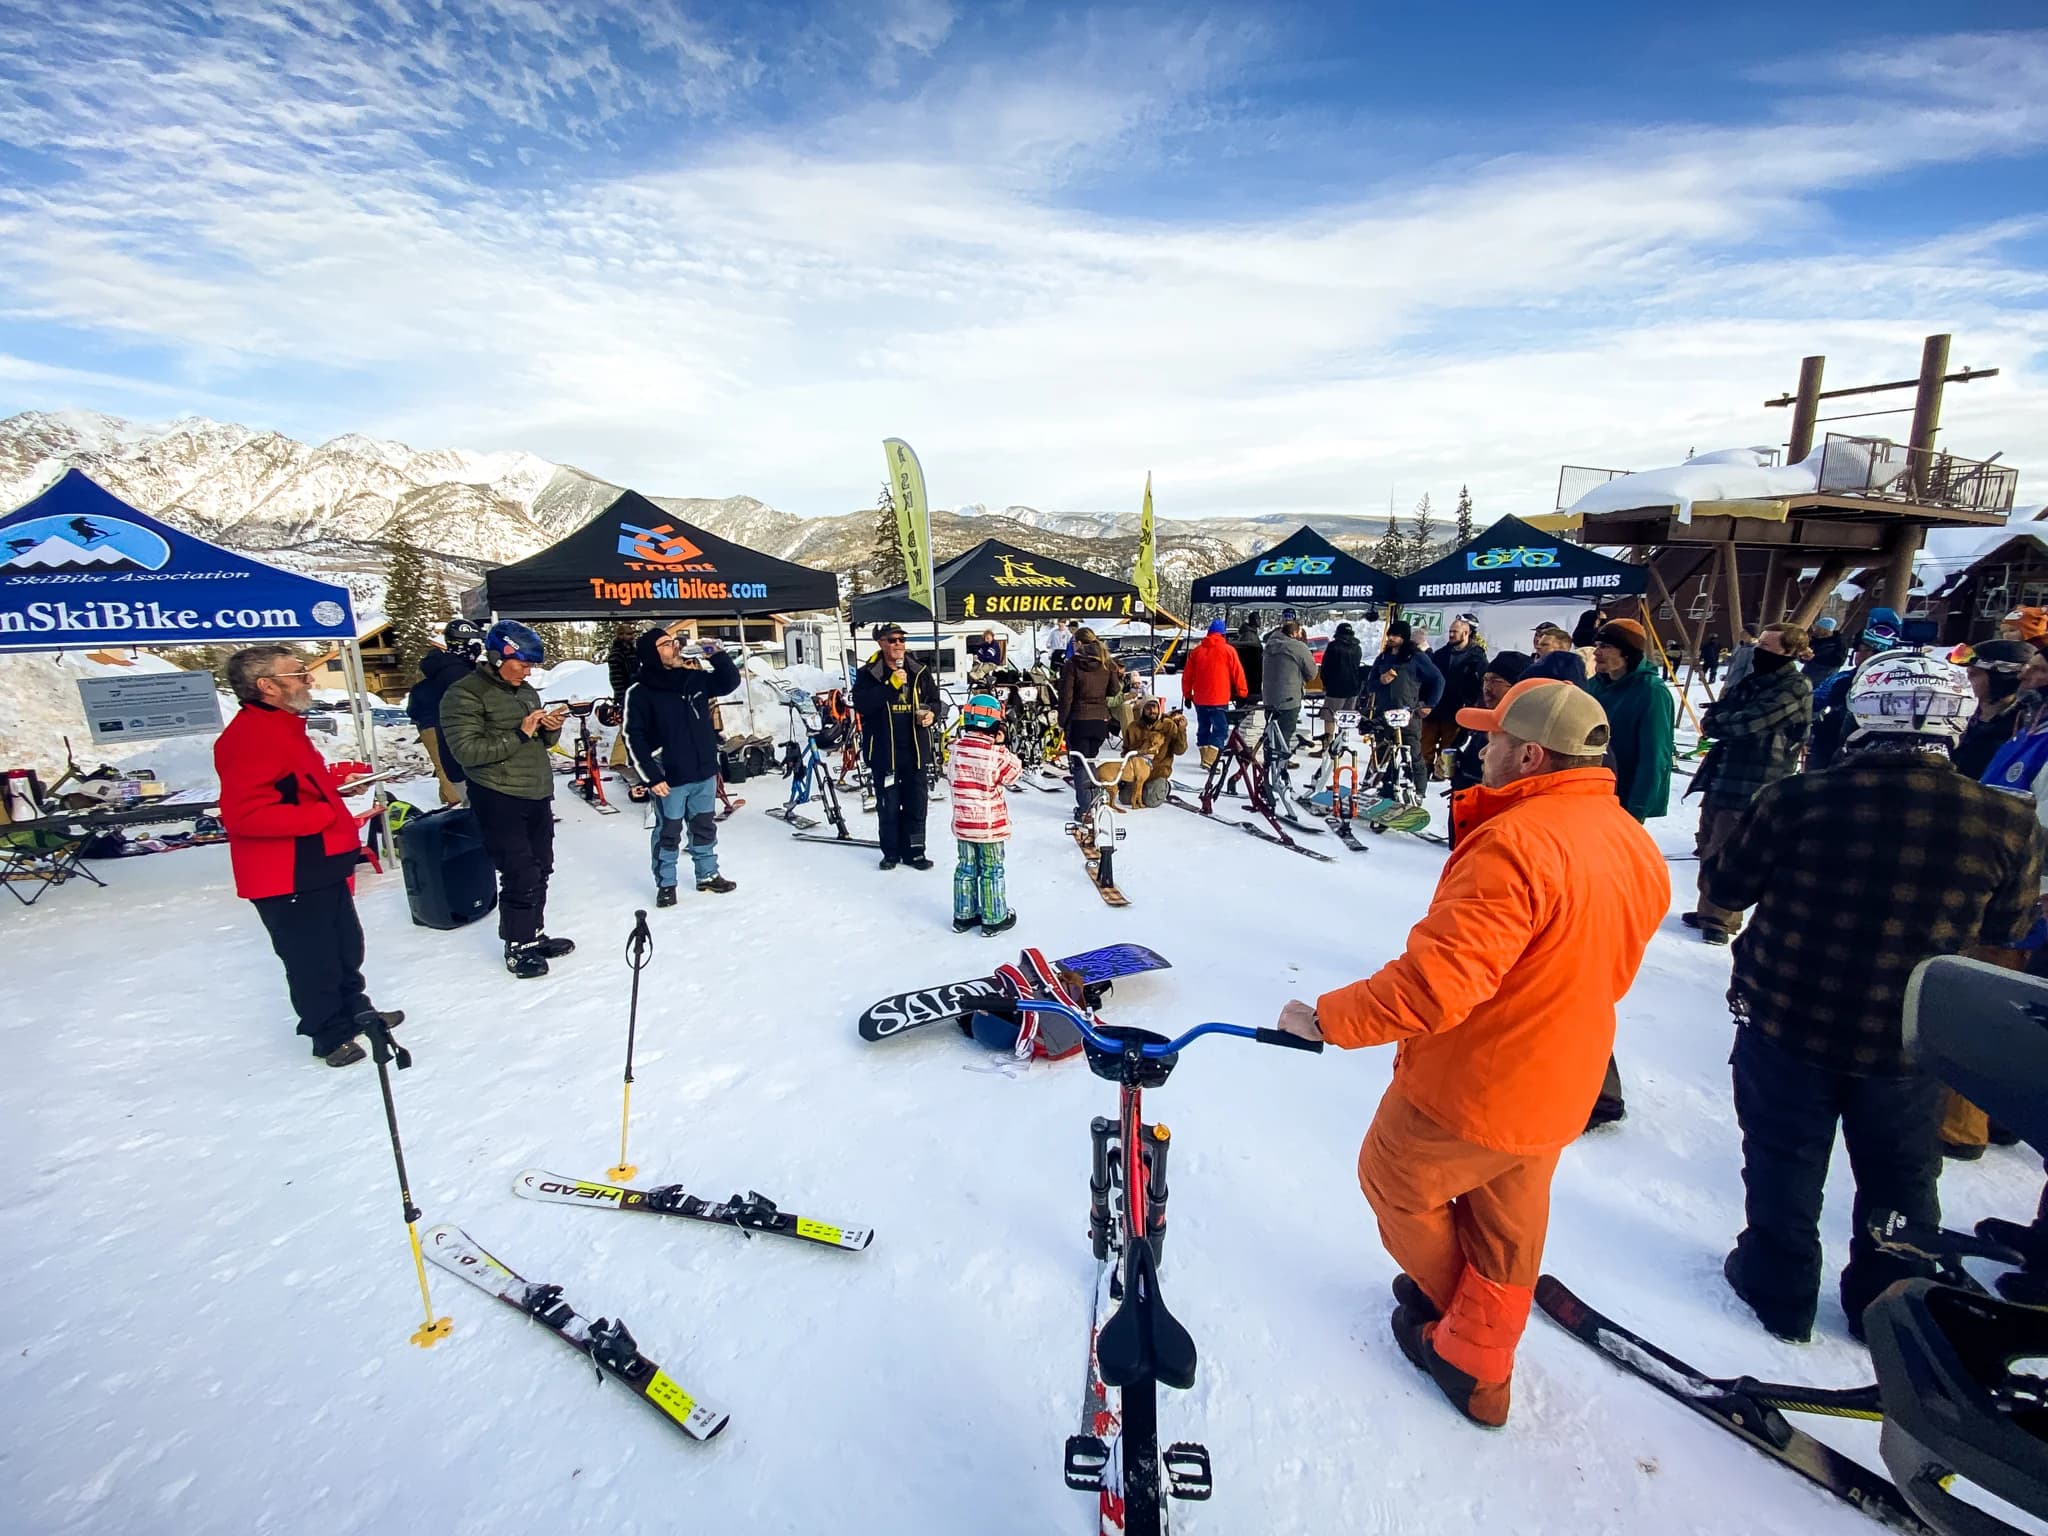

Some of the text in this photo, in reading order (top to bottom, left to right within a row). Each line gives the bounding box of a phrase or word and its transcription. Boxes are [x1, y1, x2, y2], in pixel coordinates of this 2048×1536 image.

[6, 570, 250, 585] SkiBike Association
[1419, 574, 1621, 597] PERFORMANCE MOUNTAIN BIKES
[590, 577, 768, 606] Tngntskibikes.com
[1210, 585, 1374, 597] PERFORMANCE MOUNTAIN BIKES
[986, 595, 1113, 613] SKIBIKE.COM
[1338, 713, 1356, 723] 42
[1390, 713, 1406, 722] 22
[540, 1182, 620, 1201] HEAD
